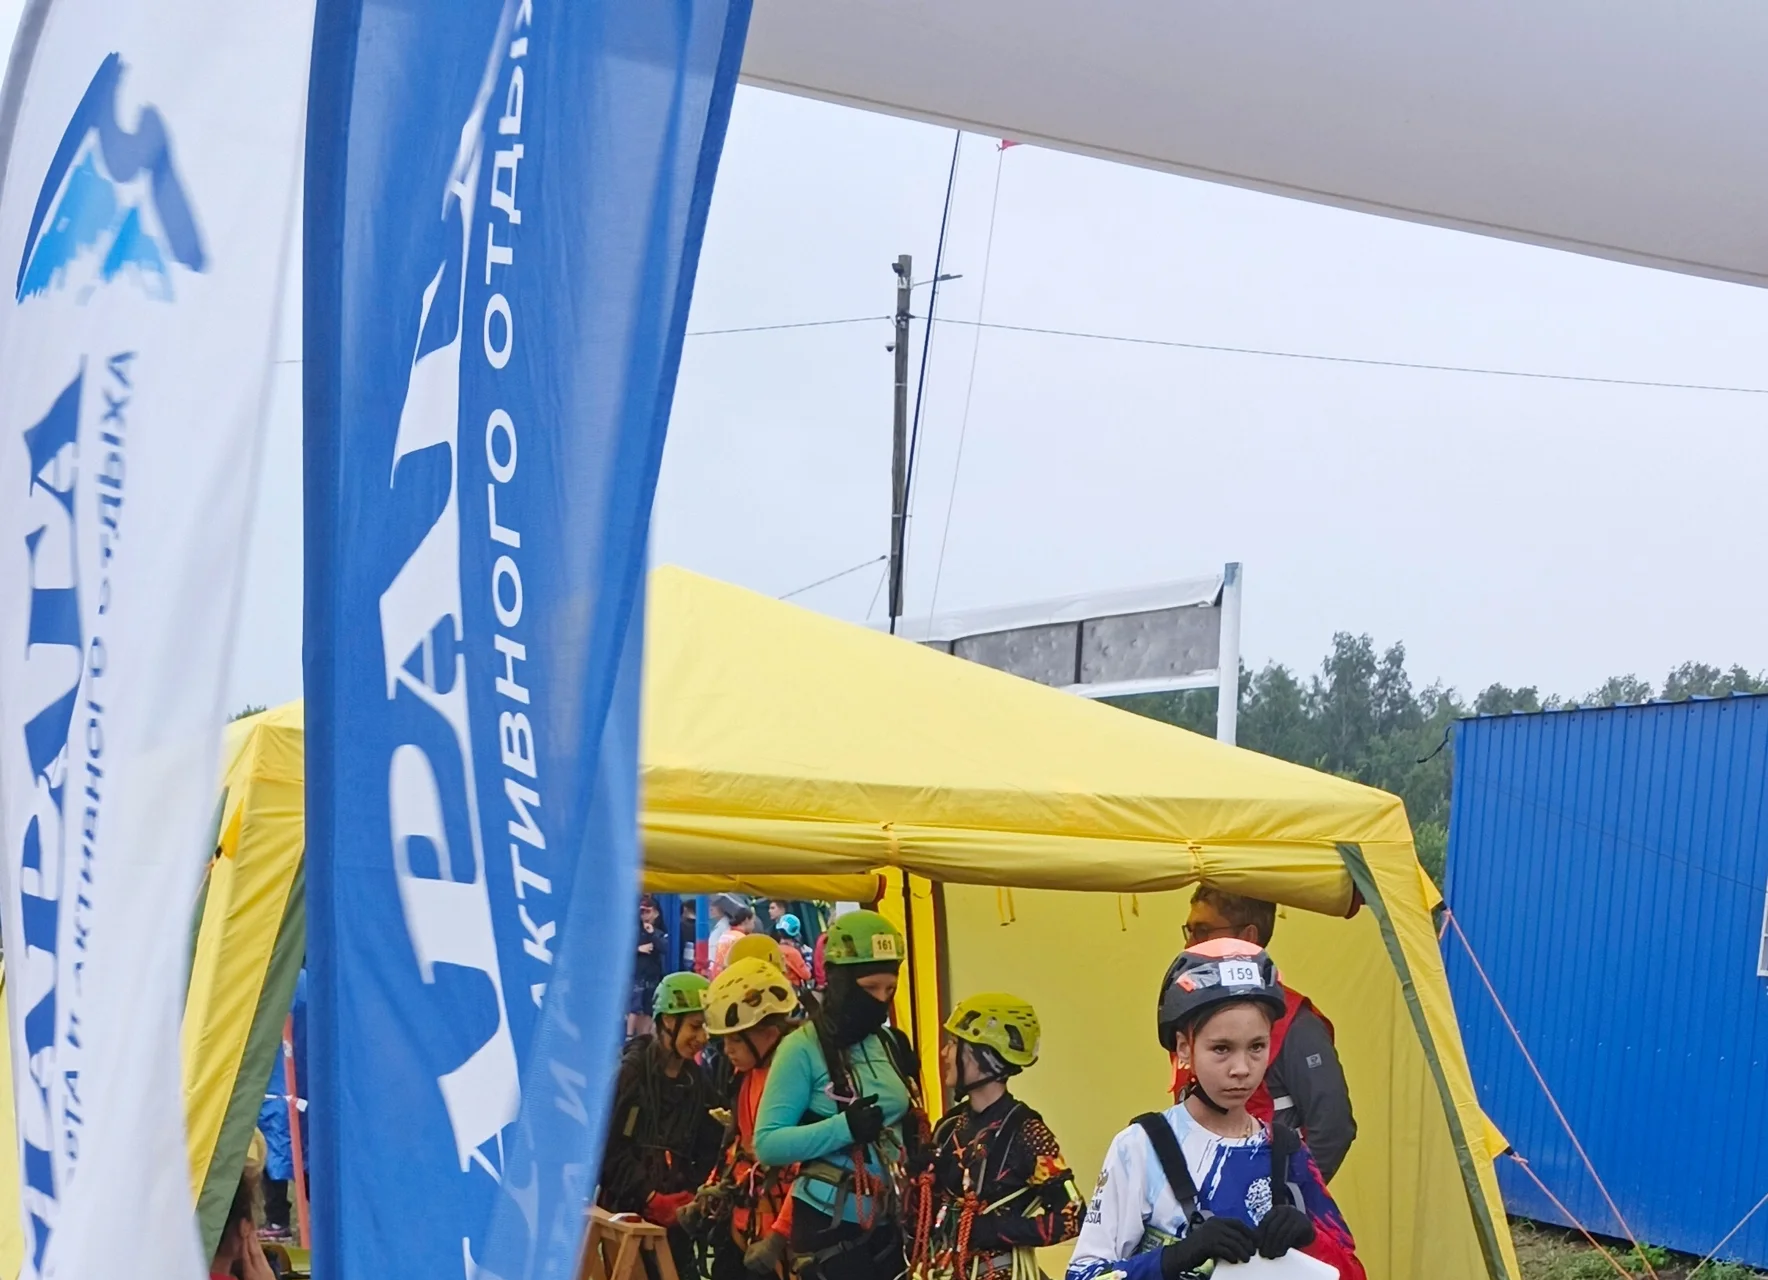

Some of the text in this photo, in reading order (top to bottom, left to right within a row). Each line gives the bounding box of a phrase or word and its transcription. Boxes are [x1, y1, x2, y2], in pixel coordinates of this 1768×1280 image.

[486, 408, 585, 1043] АКТИВНОГО
[877, 940, 892, 950] 161
[1228, 967, 1253, 980] 159
